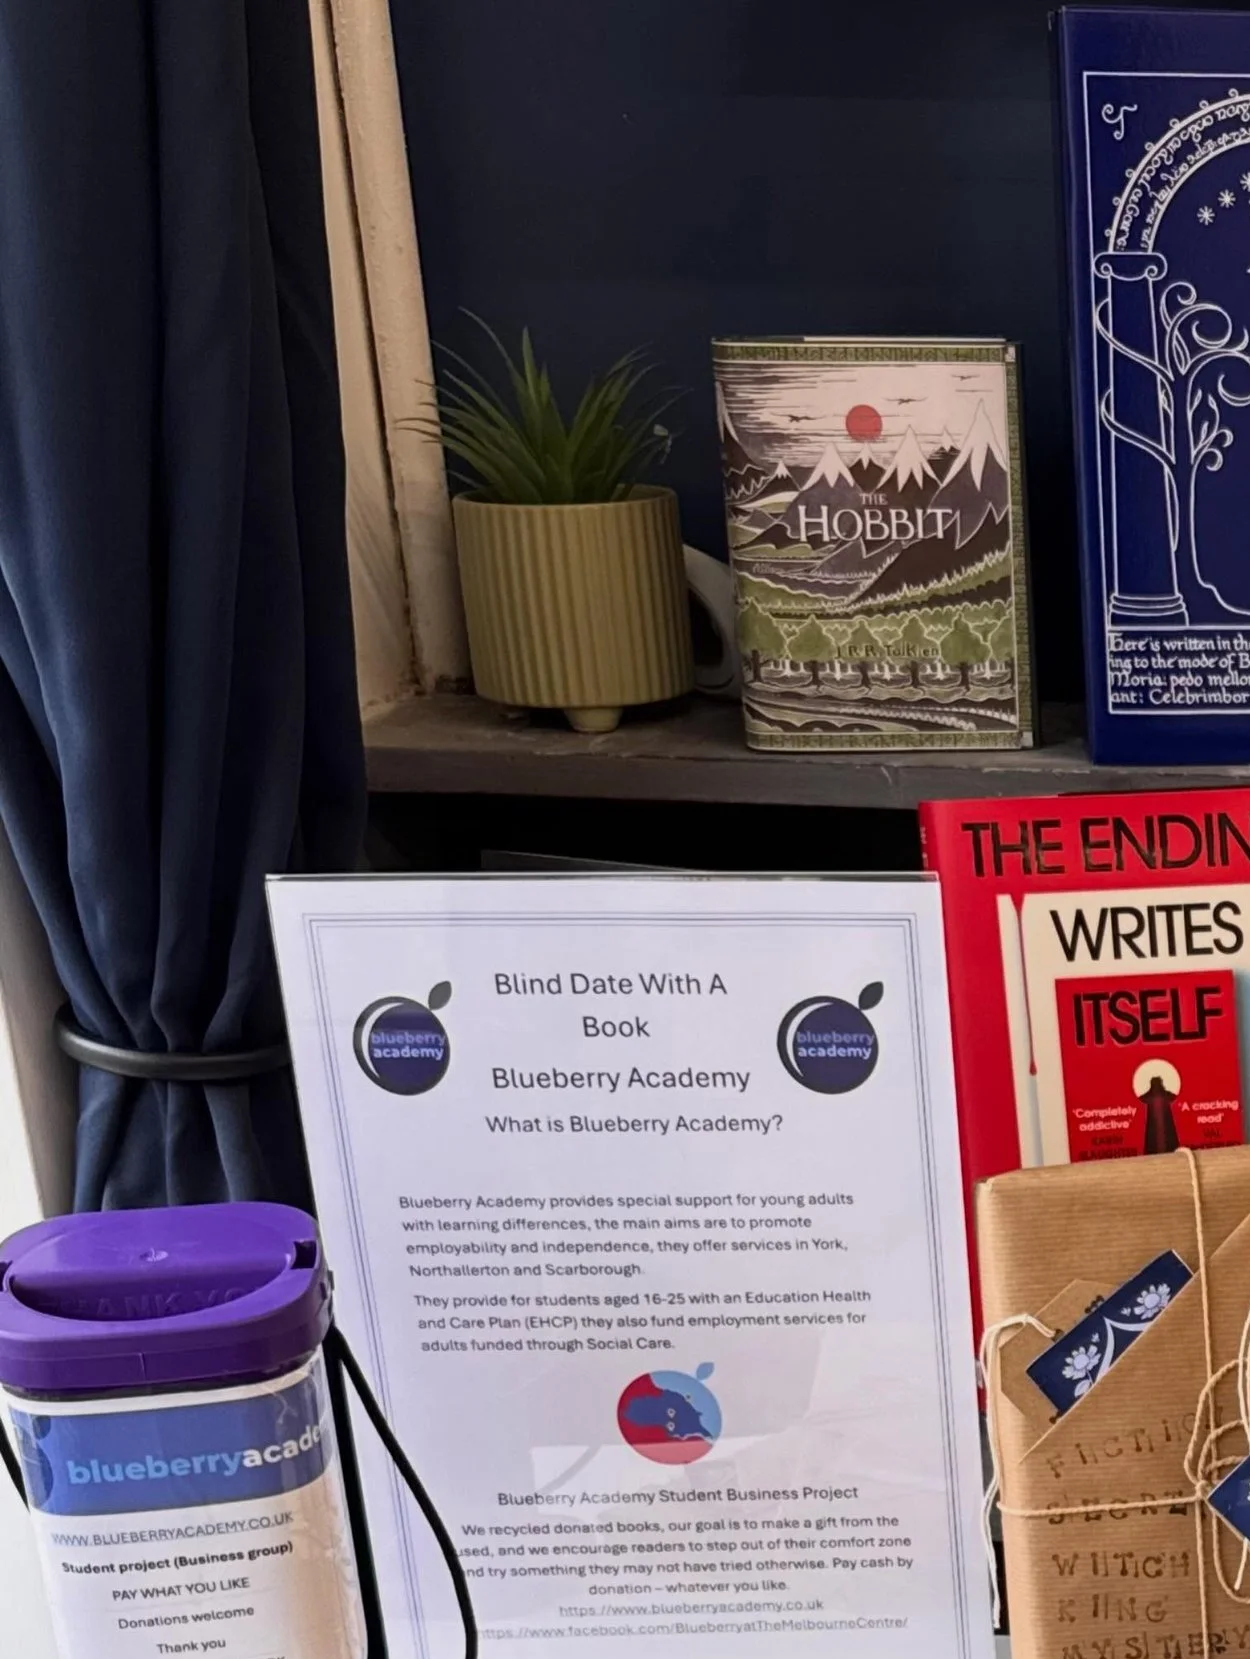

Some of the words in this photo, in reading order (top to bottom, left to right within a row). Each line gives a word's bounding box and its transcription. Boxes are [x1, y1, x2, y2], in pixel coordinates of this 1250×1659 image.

[859, 493, 888, 505] THE
[799, 506, 953, 542] HOBBIT
[1150, 636, 1161, 651] is
[1163, 636, 1216, 651] written
[1217, 635, 1231, 651] in
[1110, 654, 1132, 674] ing
[1134, 656, 1149, 669] to
[1151, 653, 1177, 669] the
[1178, 654, 1217, 669] mode
[1219, 653, 1236, 673] of
[960, 817, 1066, 878] THE
[1050, 900, 1245, 962] WRITES
[495, 973, 562, 995] Blind
[570, 973, 632, 994] Date
[639, 973, 701, 994] With
[709, 974, 727, 994] A
[1073, 985, 1224, 1046] ITSELF
[583, 1016, 650, 1037] Book
[371, 1030, 447, 1048] blueberry
[796, 1030, 876, 1048] blueberry
[372, 1044, 445, 1061] academy
[797, 1044, 873, 1061] academy
[492, 1068, 620, 1093] Blueberry
[628, 1067, 750, 1092] Academy
[1192, 1100, 1239, 1113] cracking
[485, 1116, 542, 1132] What
[547, 1120, 564, 1132] is
[570, 1116, 669, 1135] Blueberry
[676, 1115, 783, 1135] Academy?
[399, 1196, 471, 1210] Blueberry
[476, 1196, 545, 1210] Academy
[550, 1195, 613, 1209] provides
[617, 1195, 672, 1208] special
[675, 1195, 732, 1208] support
[736, 1194, 756, 1206] for
[760, 1195, 805, 1208] young
[809, 1193, 853, 1205] adults
[402, 1220, 434, 1231] with
[438, 1220, 499, 1233] learning
[502, 1218, 591, 1231] differences,
[594, 1218, 619, 1229] the
[623, 1220, 660, 1229] main
[664, 1219, 700, 1229] aims
[704, 1219, 727, 1228] are
[731, 1218, 745, 1228] to
[749, 1217, 812, 1230] promote
[498, 1492, 575, 1507] Blueberry
[580, 1492, 655, 1505] Academy
[659, 1489, 722, 1502] Student
[727, 1488, 798, 1501] Business
[803, 1487, 858, 1501] Project
[62, 1561, 116, 1575] Student
[119, 1557, 171, 1575] project
[174, 1550, 245, 1570] (Business
[247, 1540, 294, 1561] group)
[112, 1589, 138, 1602] PAY
[141, 1585, 182, 1600] WHAT
[186, 1581, 216, 1595] YOU
[220, 1577, 251, 1592] LIKE
[118, 1613, 189, 1630] Donations
[191, 1606, 255, 1622] welcome
[156, 1641, 199, 1654] Thank
[201, 1638, 226, 1653] you
